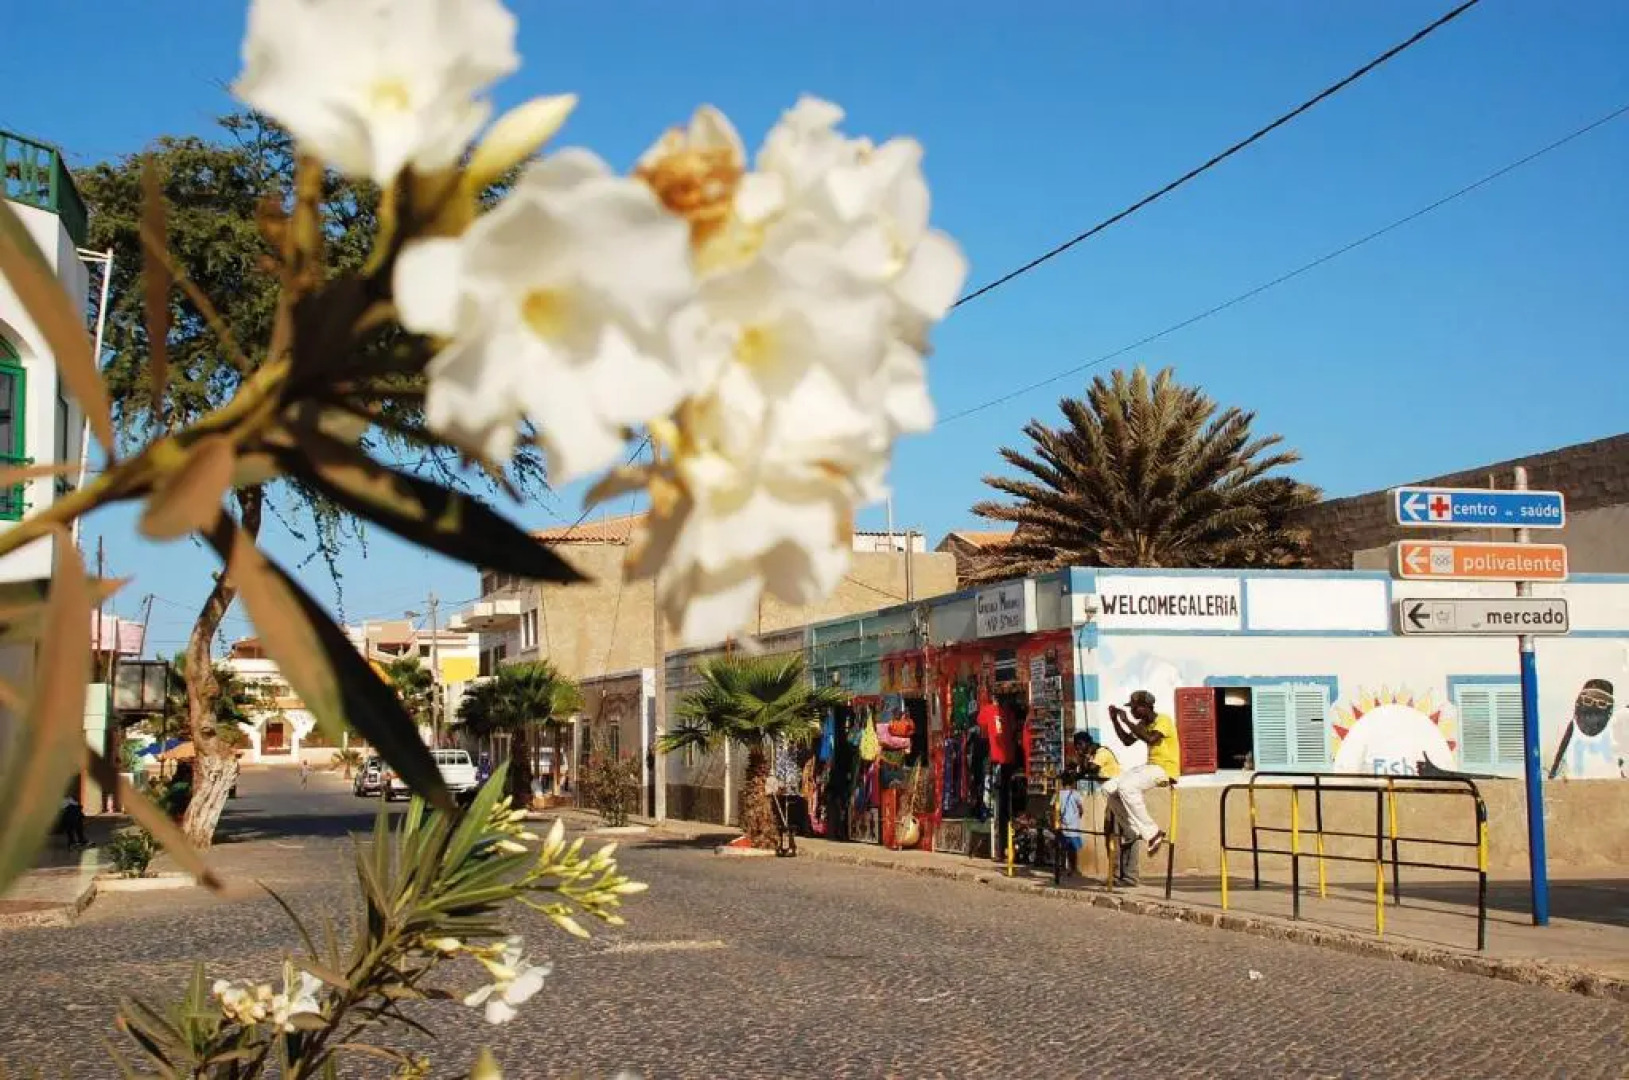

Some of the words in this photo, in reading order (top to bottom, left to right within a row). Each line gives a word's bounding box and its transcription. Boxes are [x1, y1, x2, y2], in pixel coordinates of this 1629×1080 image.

[1453, 502, 1497, 516] centro
[1520, 503, 1560, 517] saúde
[1463, 555, 1562, 572] polivalente
[1486, 607, 1564, 624] mercado
